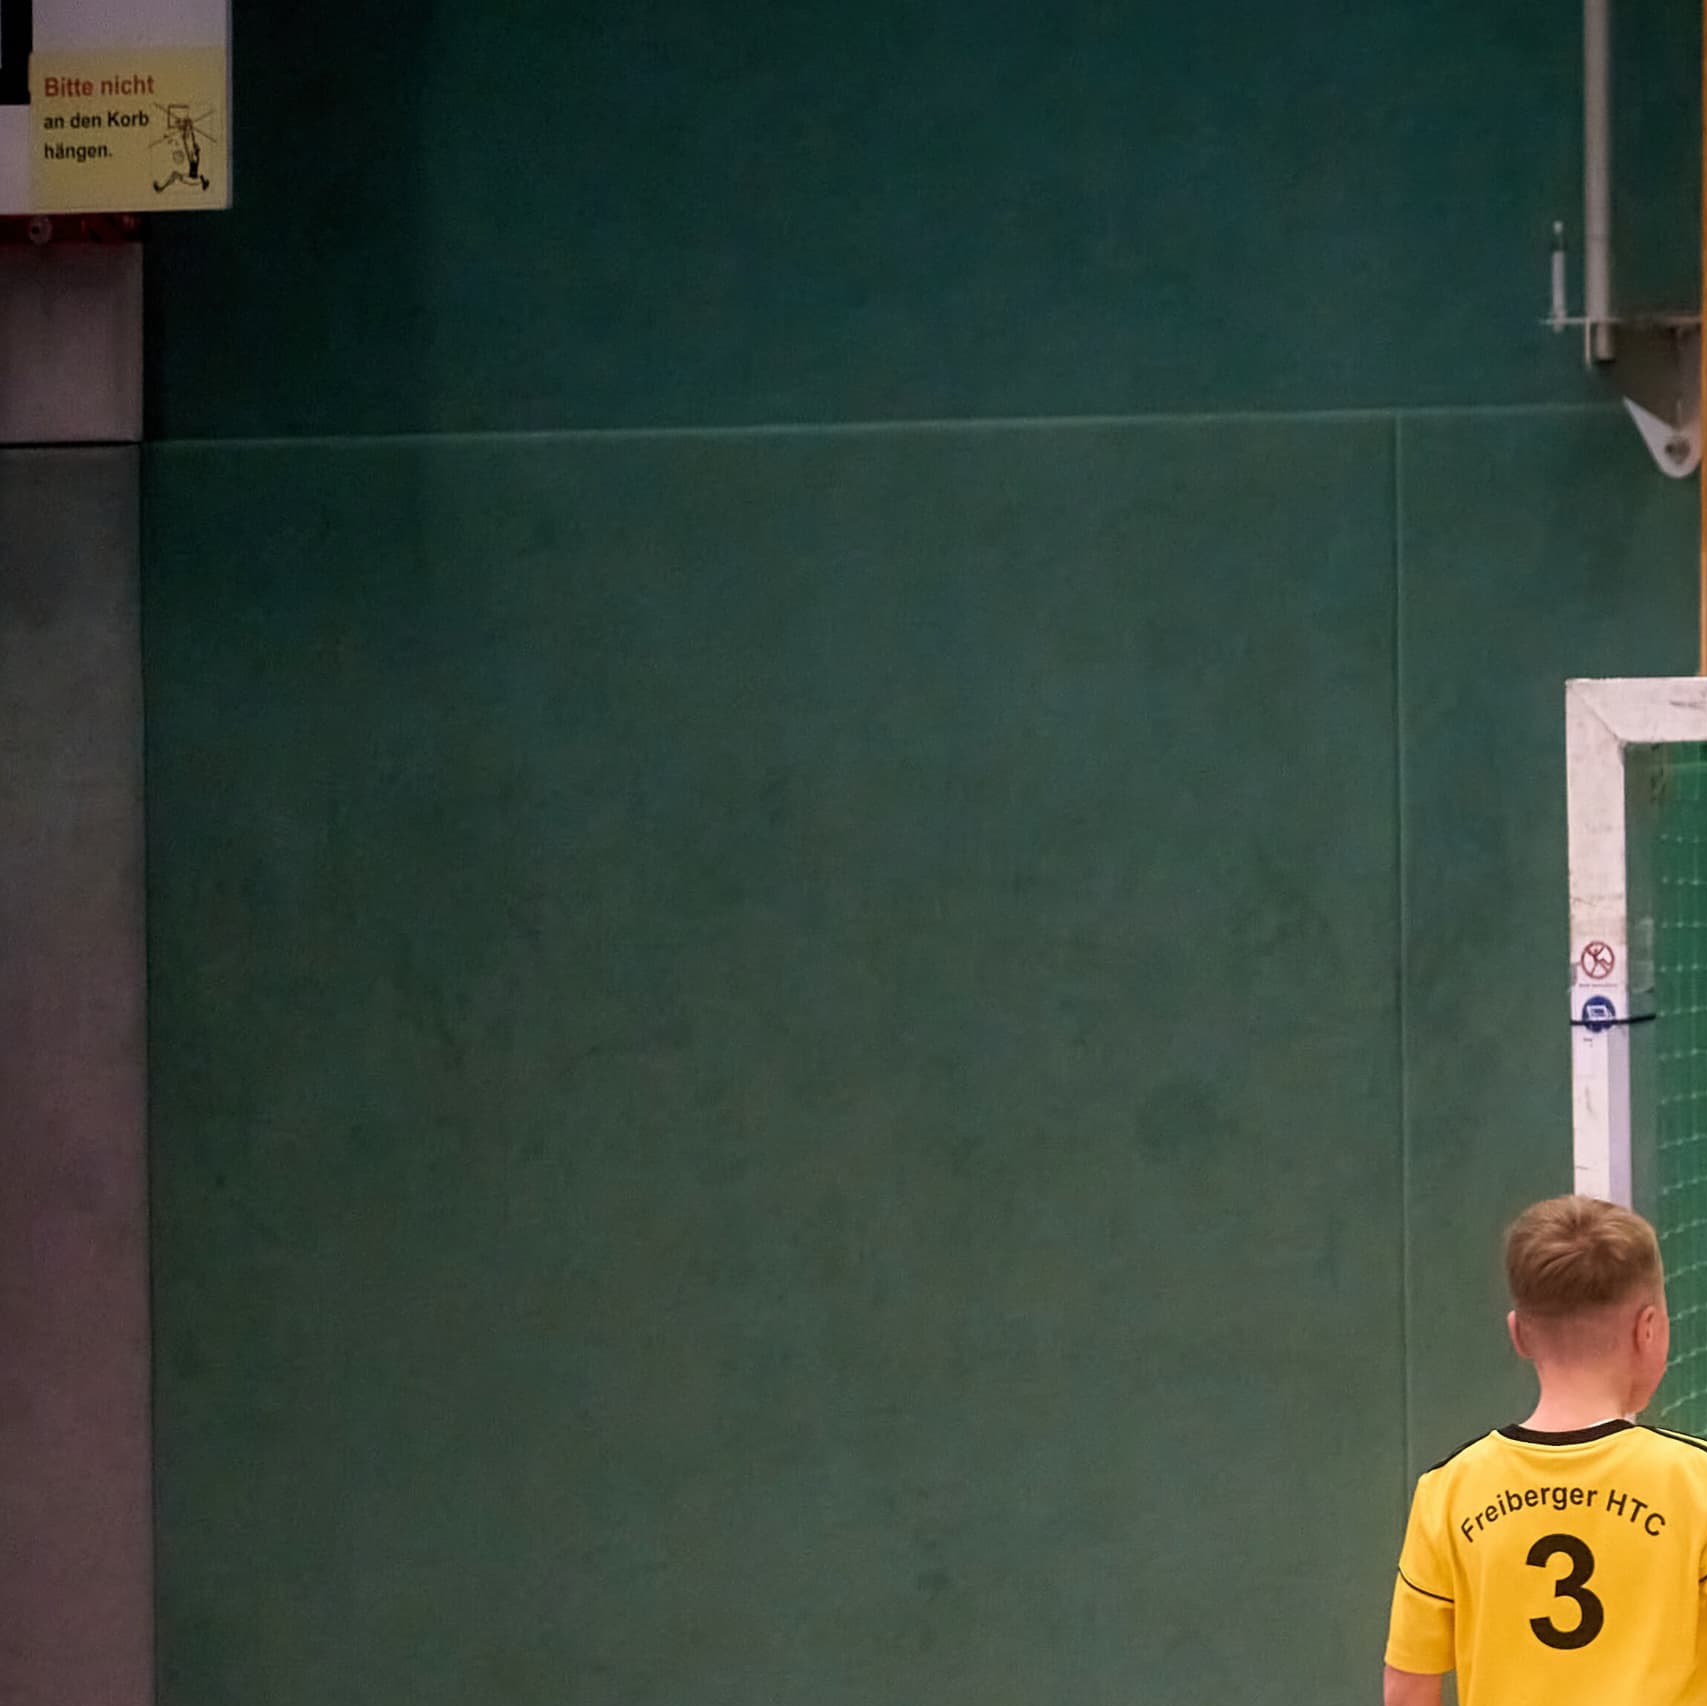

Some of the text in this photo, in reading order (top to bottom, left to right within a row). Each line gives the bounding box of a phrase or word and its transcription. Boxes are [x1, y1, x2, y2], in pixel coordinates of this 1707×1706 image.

[44, 75, 154, 97] Bitte nicht
[44, 110, 149, 130] an den Korb
[44, 143, 112, 162] hängen.
[1460, 1486, 1666, 1543] Freiberger HTC
[1526, 1533, 1604, 1650] 3
